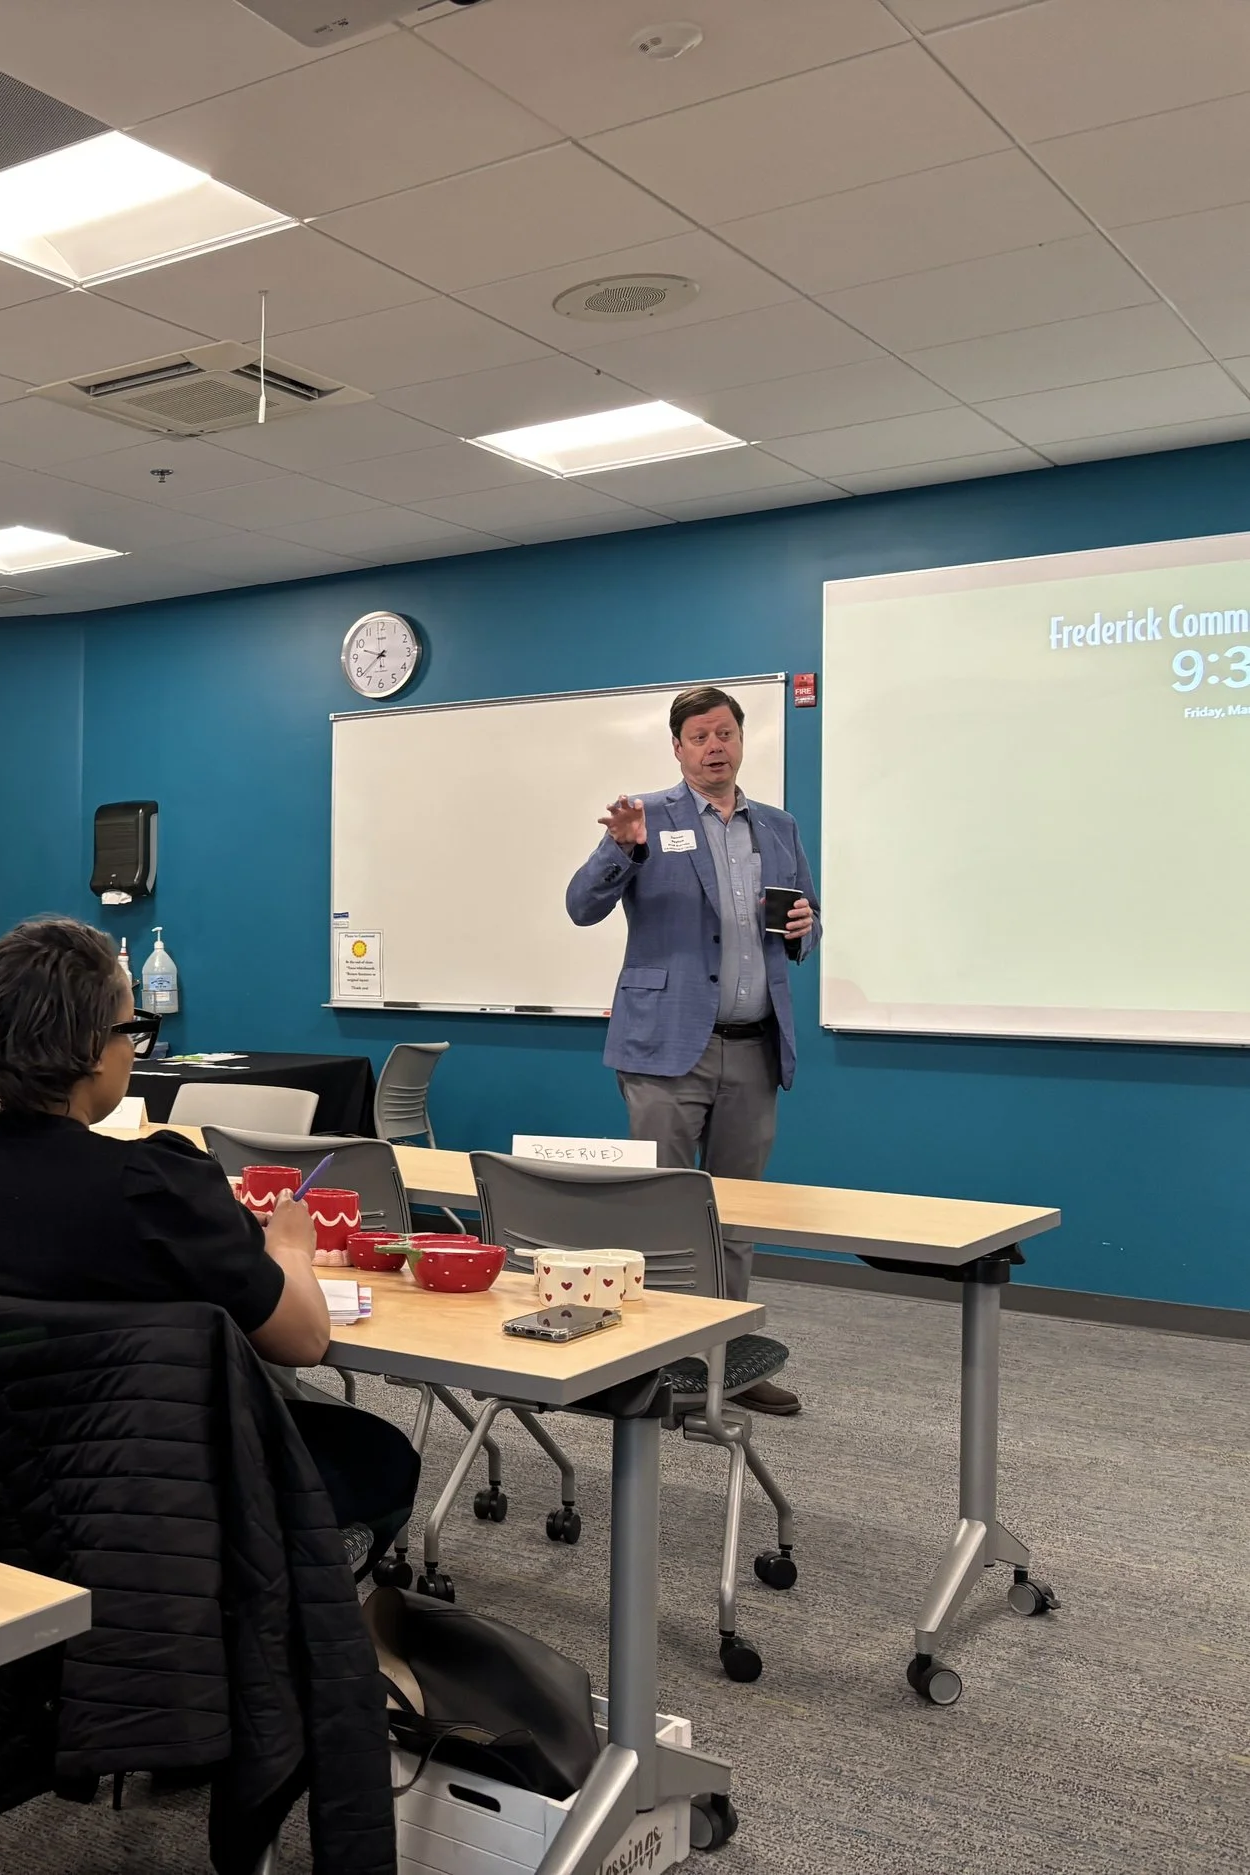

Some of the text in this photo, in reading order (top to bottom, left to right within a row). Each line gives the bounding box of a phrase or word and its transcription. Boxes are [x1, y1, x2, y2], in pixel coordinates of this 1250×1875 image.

[1049, 604, 1249, 650] Frederick Comm
[356, 639, 365, 648] 10
[402, 634, 408, 643] 2
[406, 647, 411, 657] 3
[352, 653, 359, 663] 9
[1171, 645, 1250, 692] 9:3
[366, 676, 372, 686] 7
[391, 673, 397, 683] 5
[377, 679, 384, 688] 6
[795, 687, 812, 695] FIRE
[1184, 706, 1226, 718] Friday,
[532, 1144, 624, 1162] RESERVED
